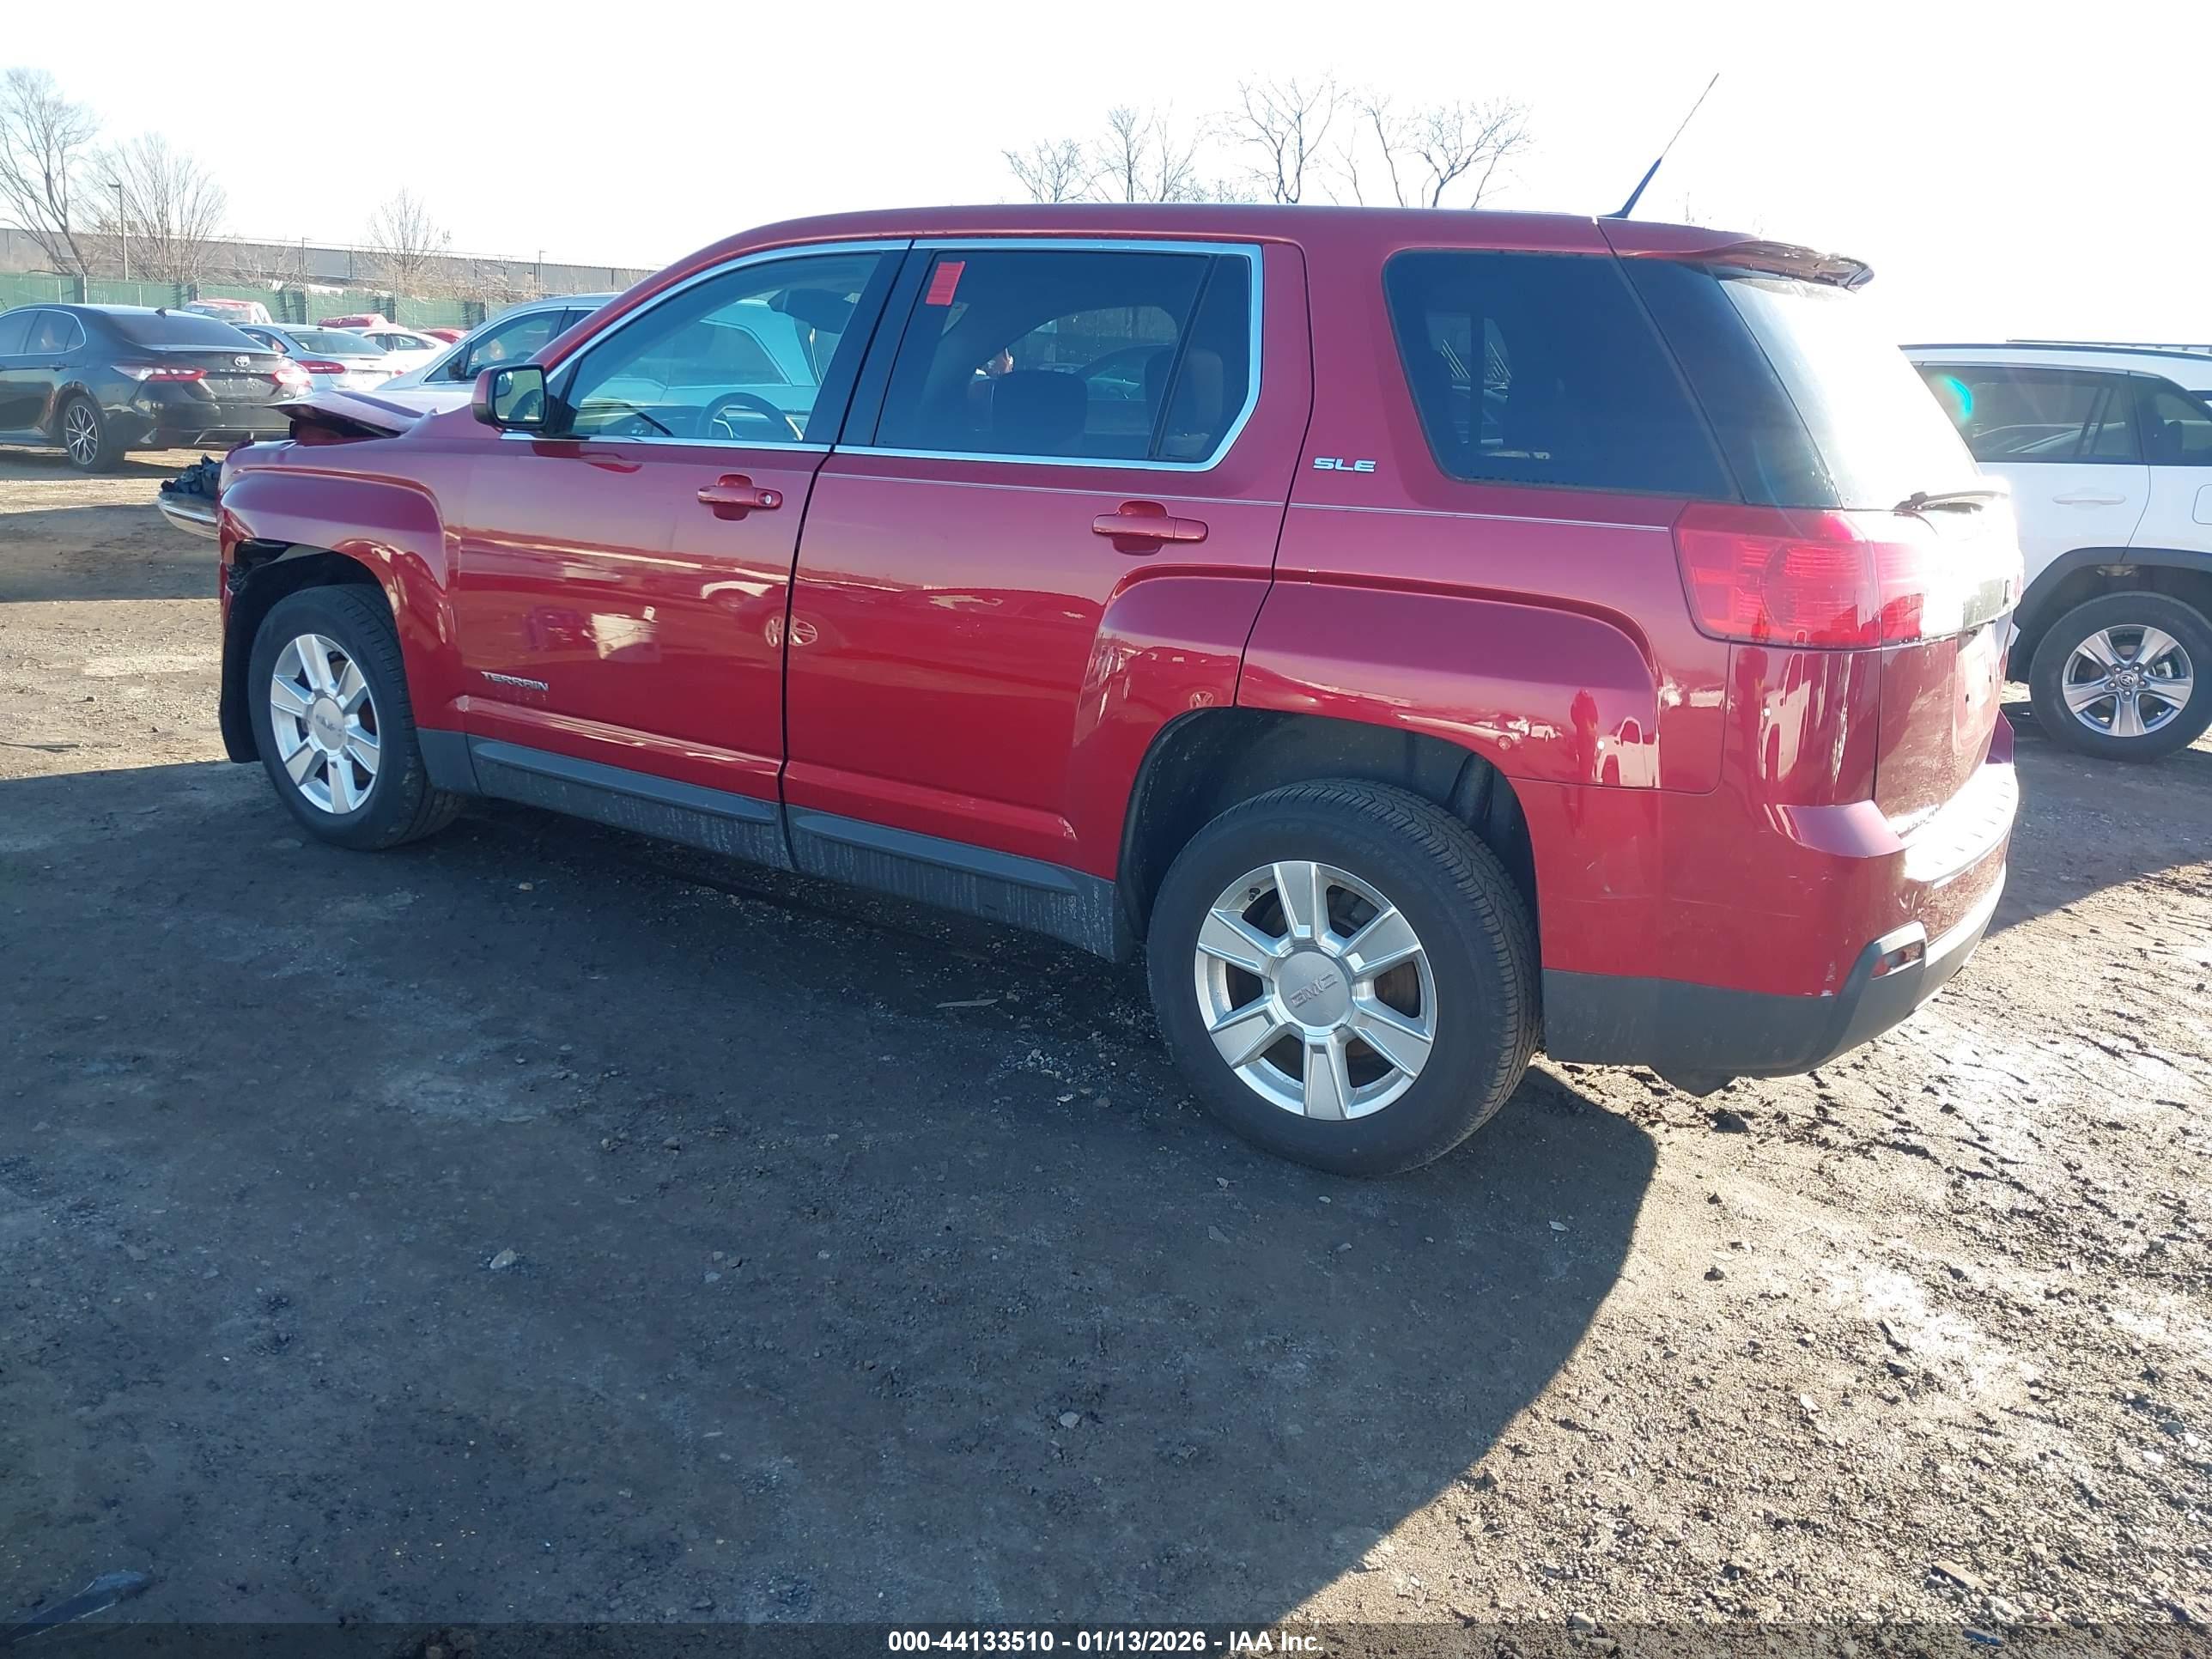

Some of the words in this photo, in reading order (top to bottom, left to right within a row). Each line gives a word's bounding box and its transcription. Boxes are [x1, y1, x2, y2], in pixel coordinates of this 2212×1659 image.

[1313, 457, 1376, 473] SLE
[480, 671, 550, 691] TERRAIN
[1290, 973, 1338, 1007] GMC
